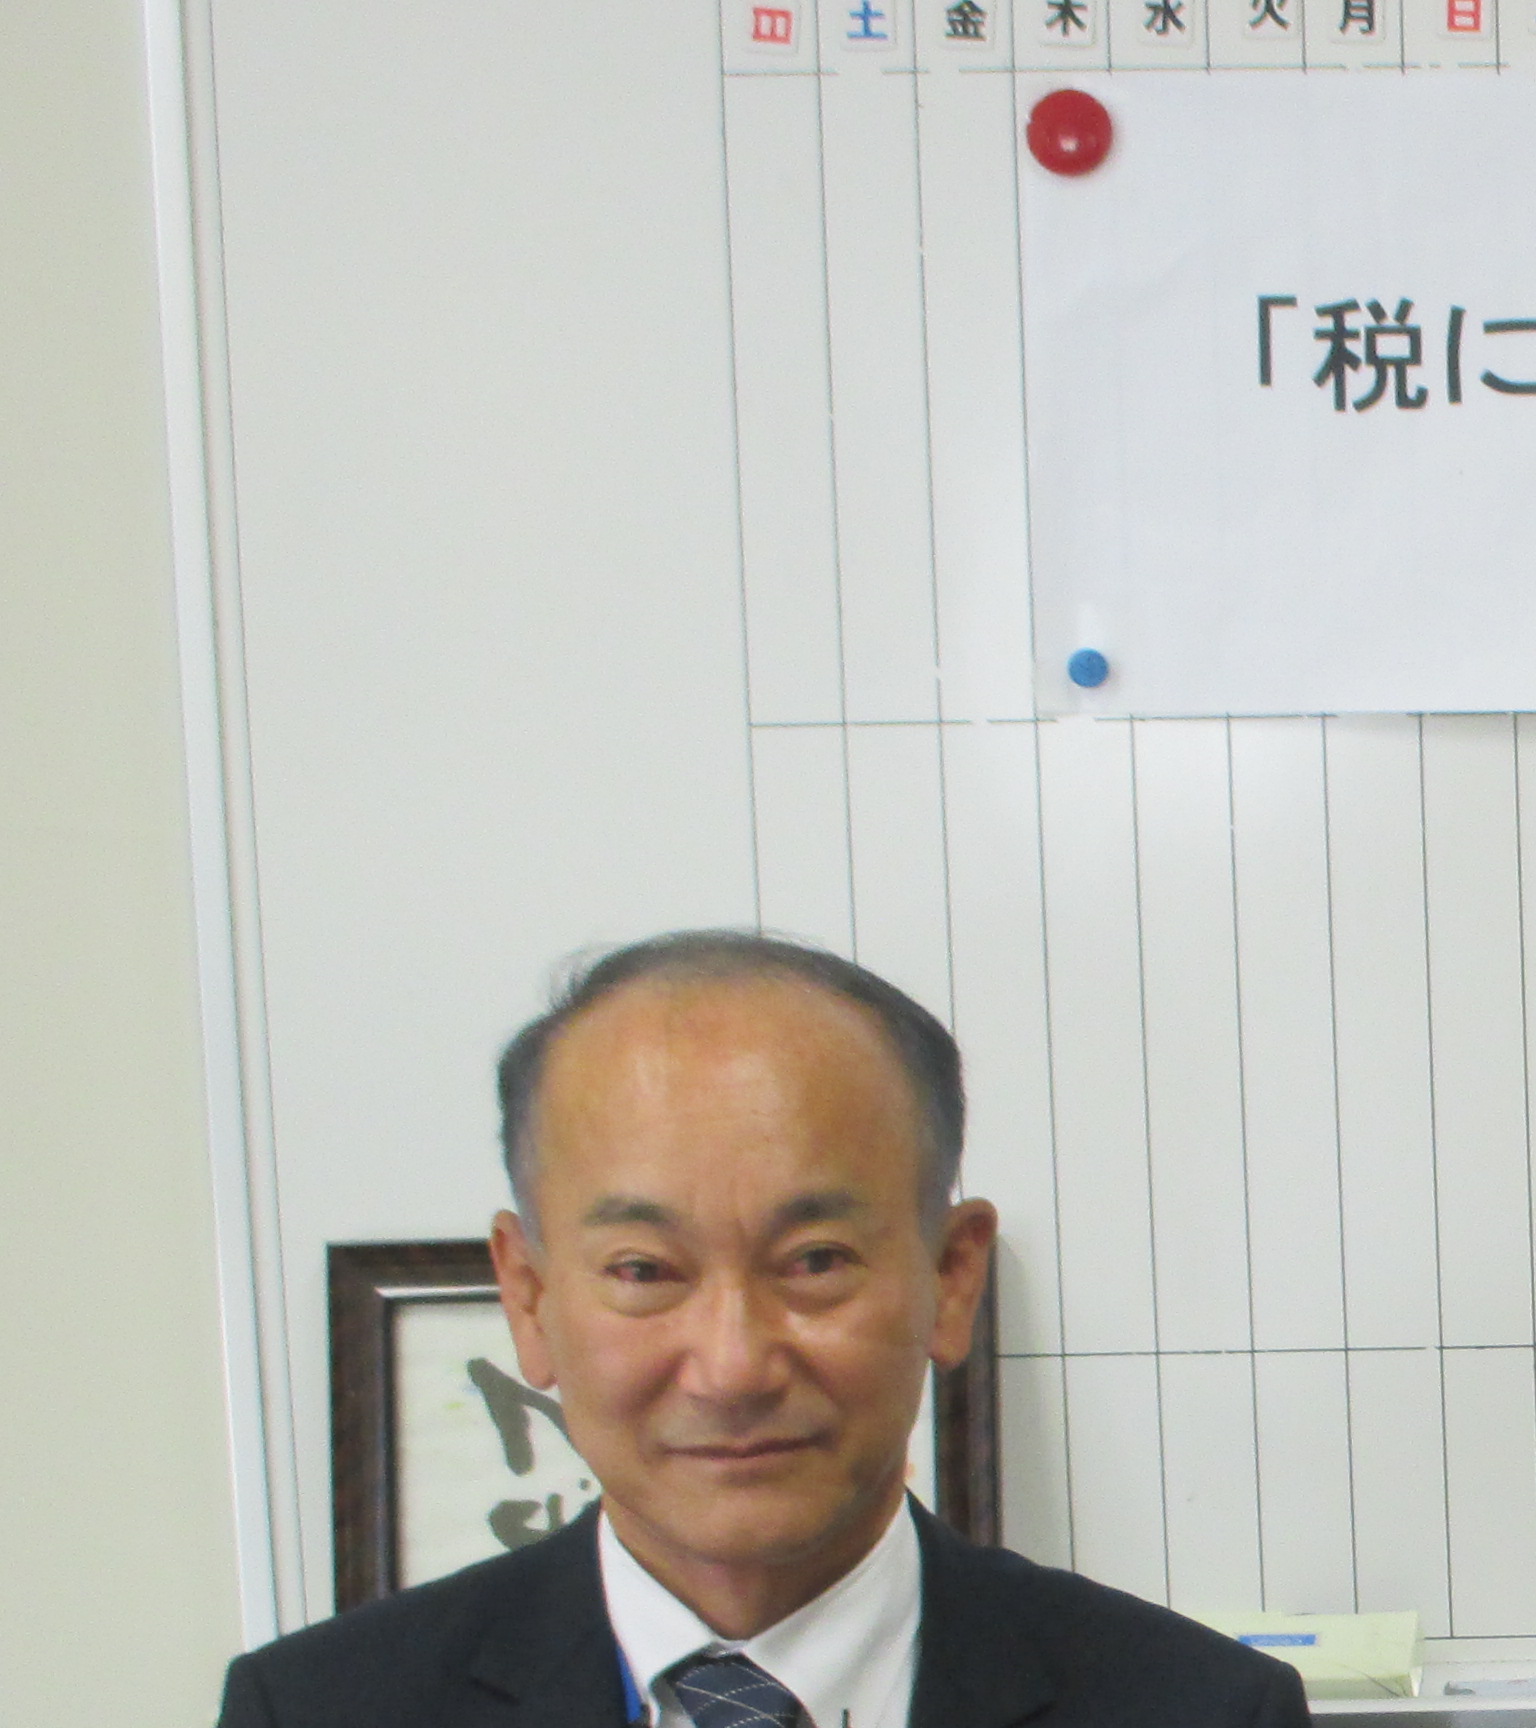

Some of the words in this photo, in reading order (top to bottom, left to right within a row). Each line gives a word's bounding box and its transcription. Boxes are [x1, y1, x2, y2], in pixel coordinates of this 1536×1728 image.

[846, 0, 888, 39] 土
[945, 0, 987, 42] 金
[1045, 0, 1088, 37] 木
[1144, 0, 1186, 36] 水
[1249, 0, 1289, 31] 火
[1338, 0, 1376, 35] 月
[1446, 0, 1482, 33] 日
